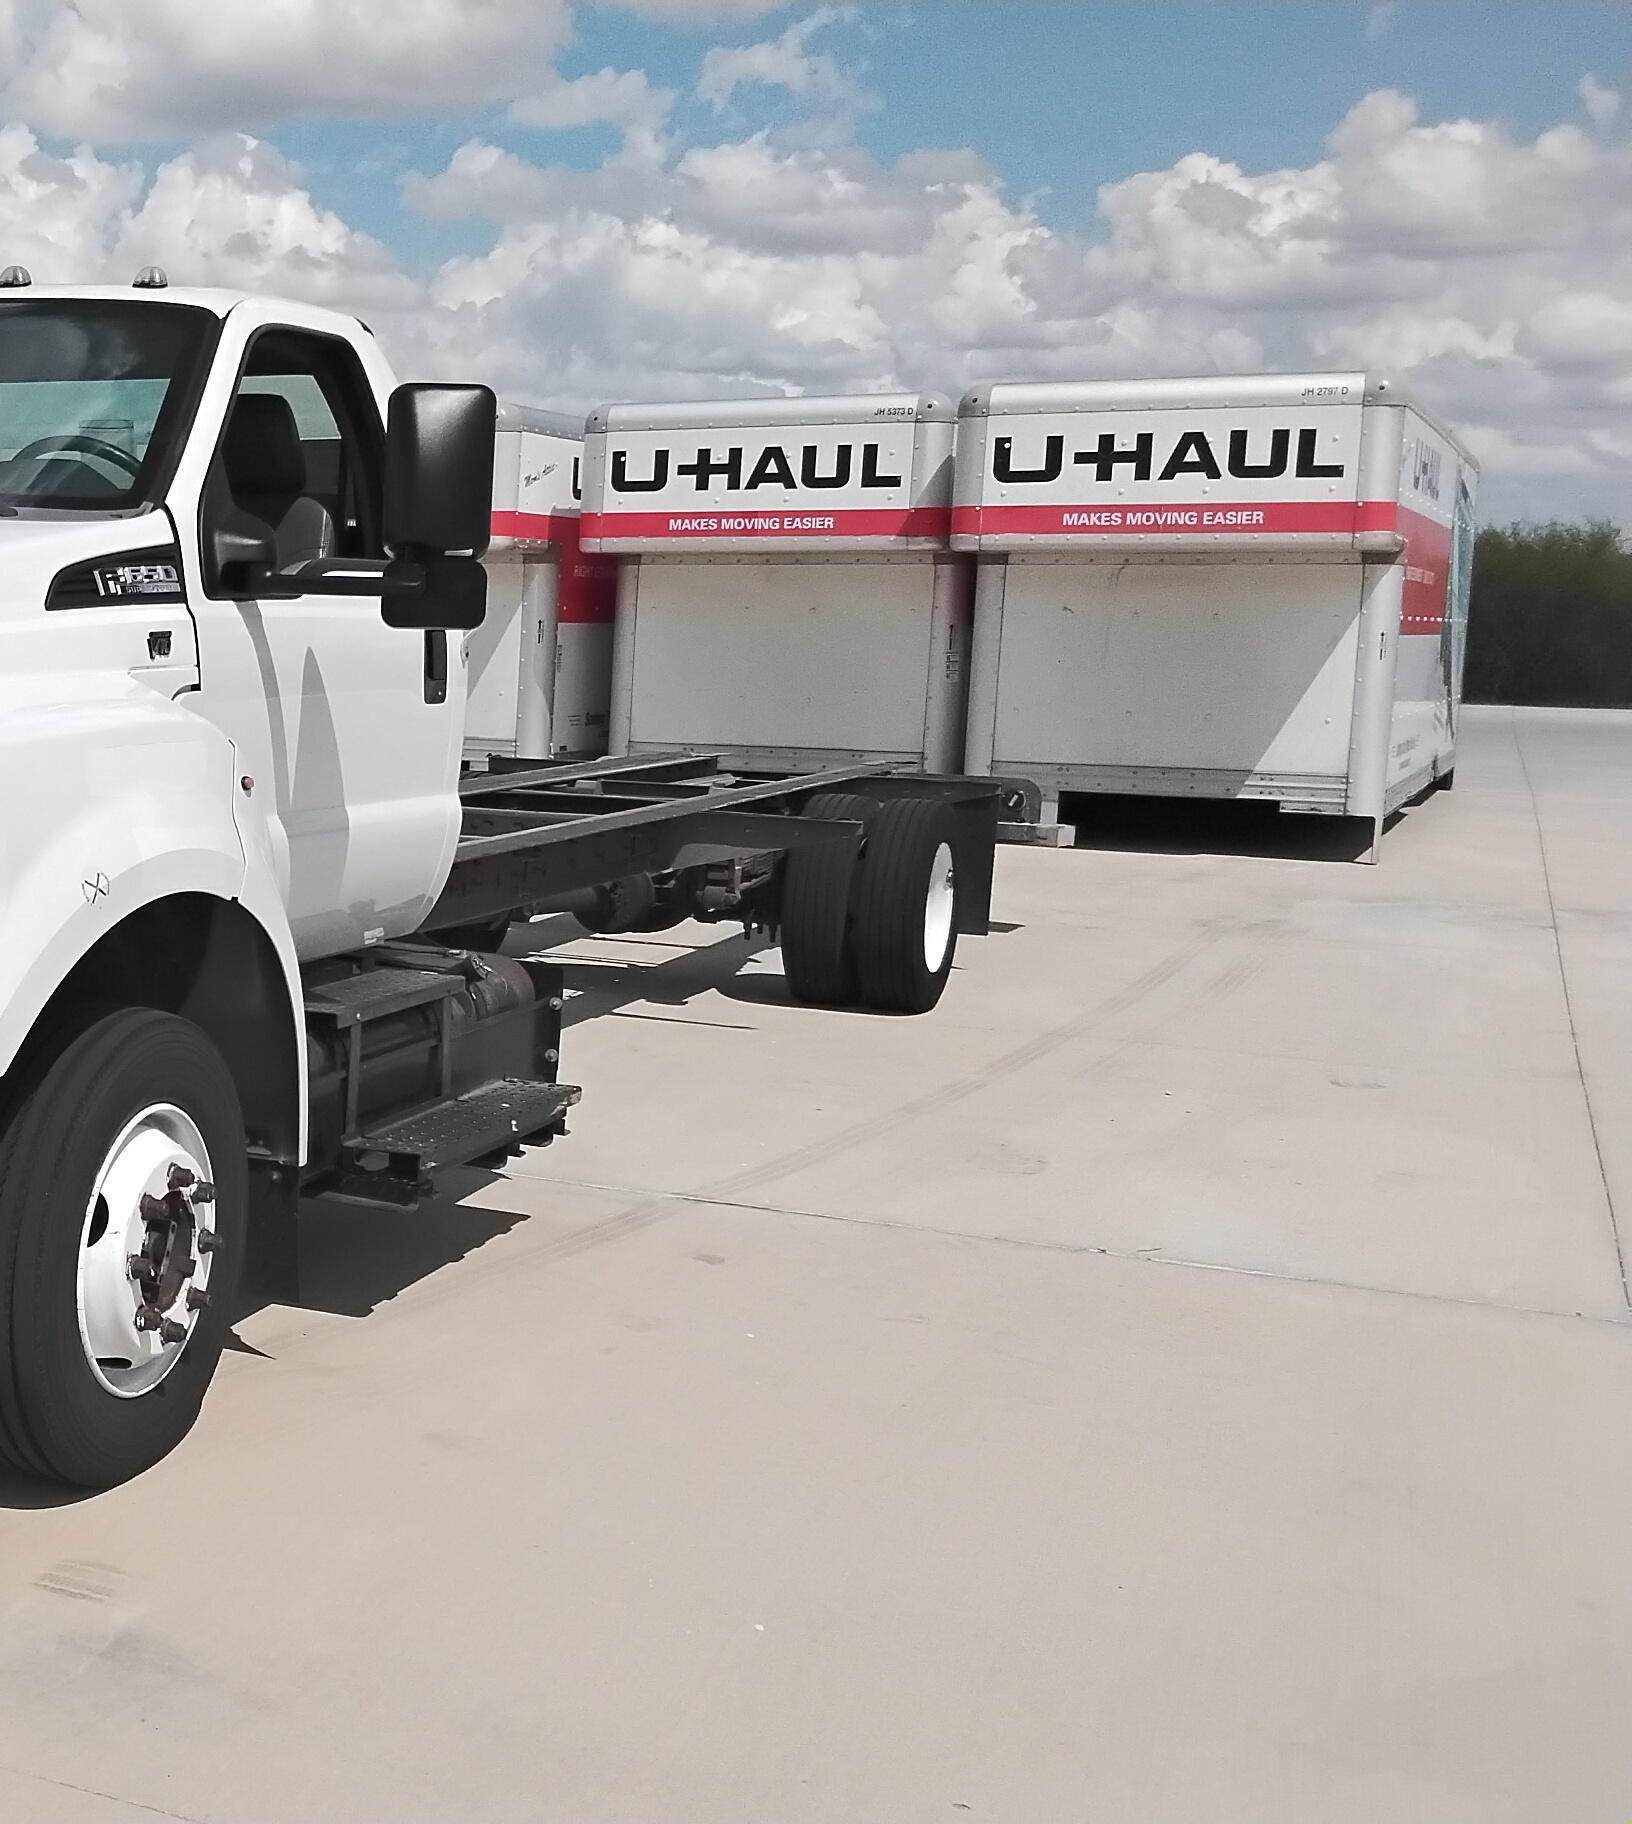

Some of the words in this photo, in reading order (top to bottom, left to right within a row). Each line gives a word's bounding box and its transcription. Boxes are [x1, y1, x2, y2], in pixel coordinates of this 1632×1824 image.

[1301, 387, 1314, 396] JH
[1341, 386, 1349, 395] D
[874, 408, 885, 416] JH
[907, 407, 914, 415] D
[669, 518, 718, 531] MAKES
[721, 518, 780, 530] MOVING
[783, 517, 835, 529] EASIER
[1062, 512, 1122, 526] MAKES
[1126, 511, 1198, 526] MOVING
[1202, 511, 1264, 525] EASIER
